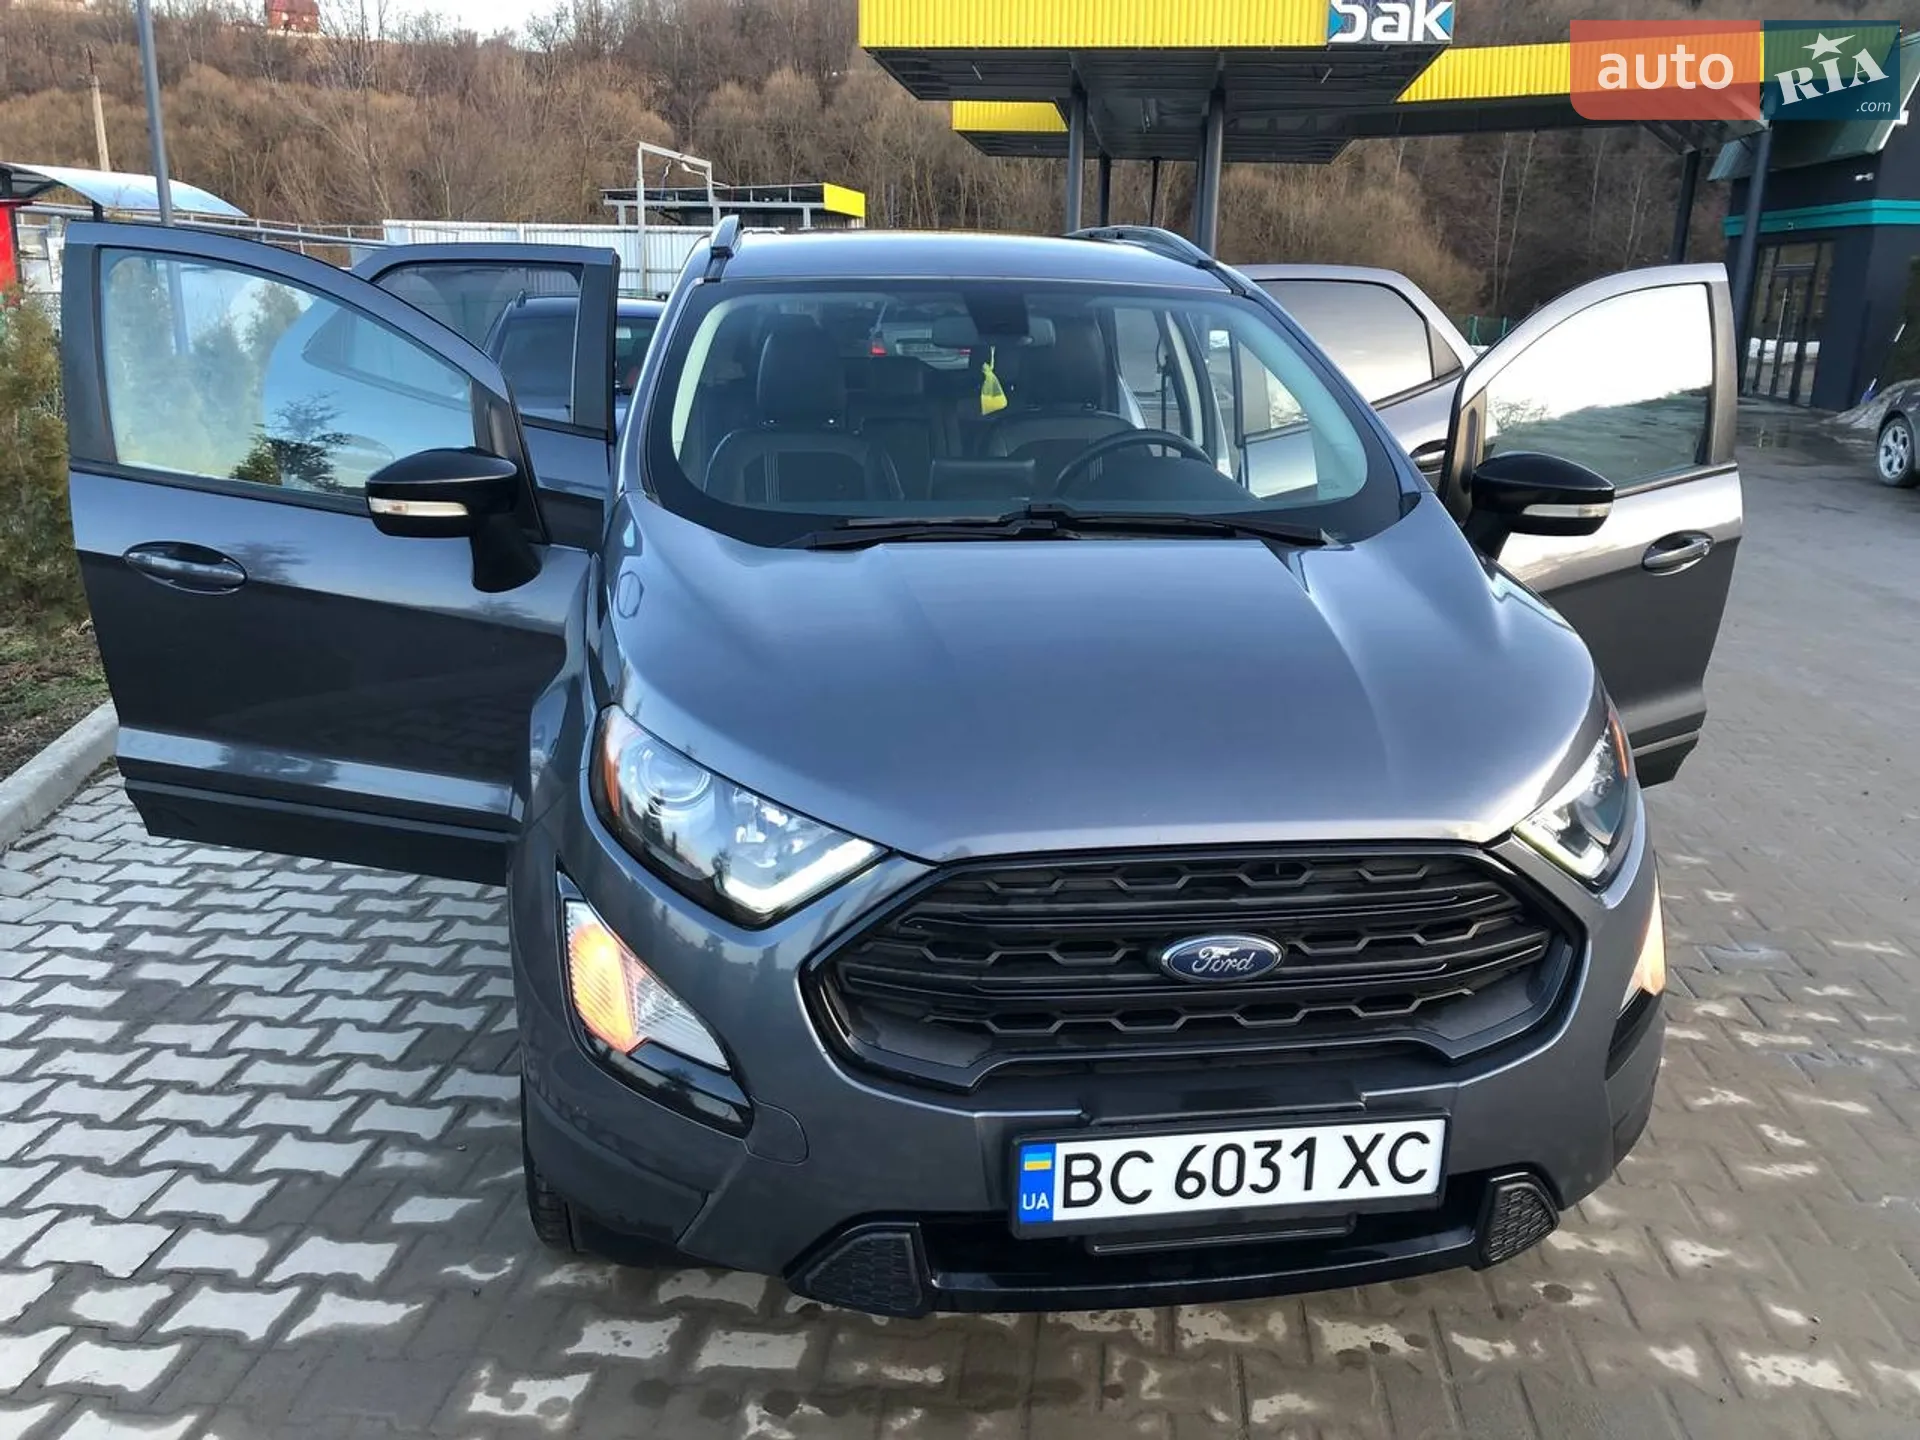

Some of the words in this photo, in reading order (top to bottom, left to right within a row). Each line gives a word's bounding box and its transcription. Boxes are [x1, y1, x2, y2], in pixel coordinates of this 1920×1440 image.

[1192, 946, 1256, 973] Ford
[1062, 1150, 1155, 1209] BC
[1174, 1136, 1318, 1200] 6031
[1337, 1131, 1431, 1190] XC
[1022, 1191, 1050, 1211] UA
